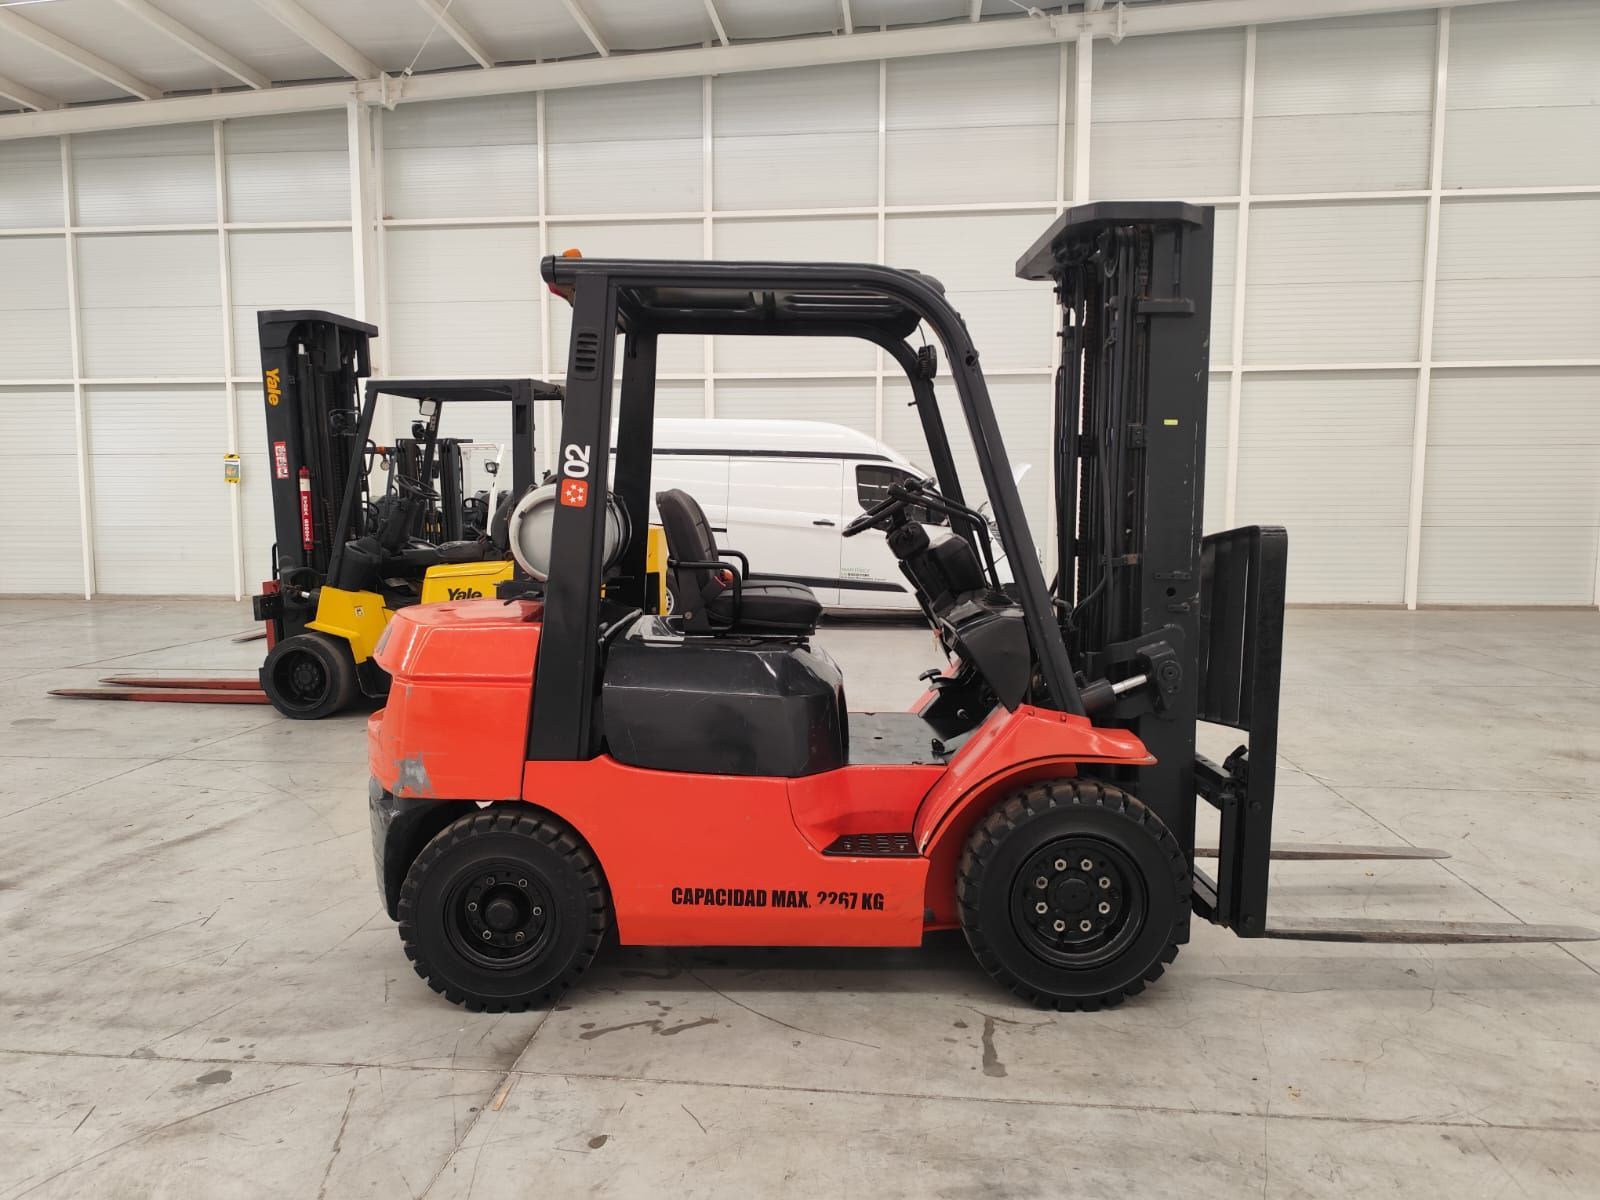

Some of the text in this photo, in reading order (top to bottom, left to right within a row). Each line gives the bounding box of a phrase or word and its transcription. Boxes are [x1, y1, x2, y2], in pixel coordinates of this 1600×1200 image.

[265, 368, 281, 406] Yale
[563, 443, 591, 479] 02
[447, 587, 483, 601] Yale
[671, 887, 885, 911] CAPACIDAD MAX. 2267 KG
